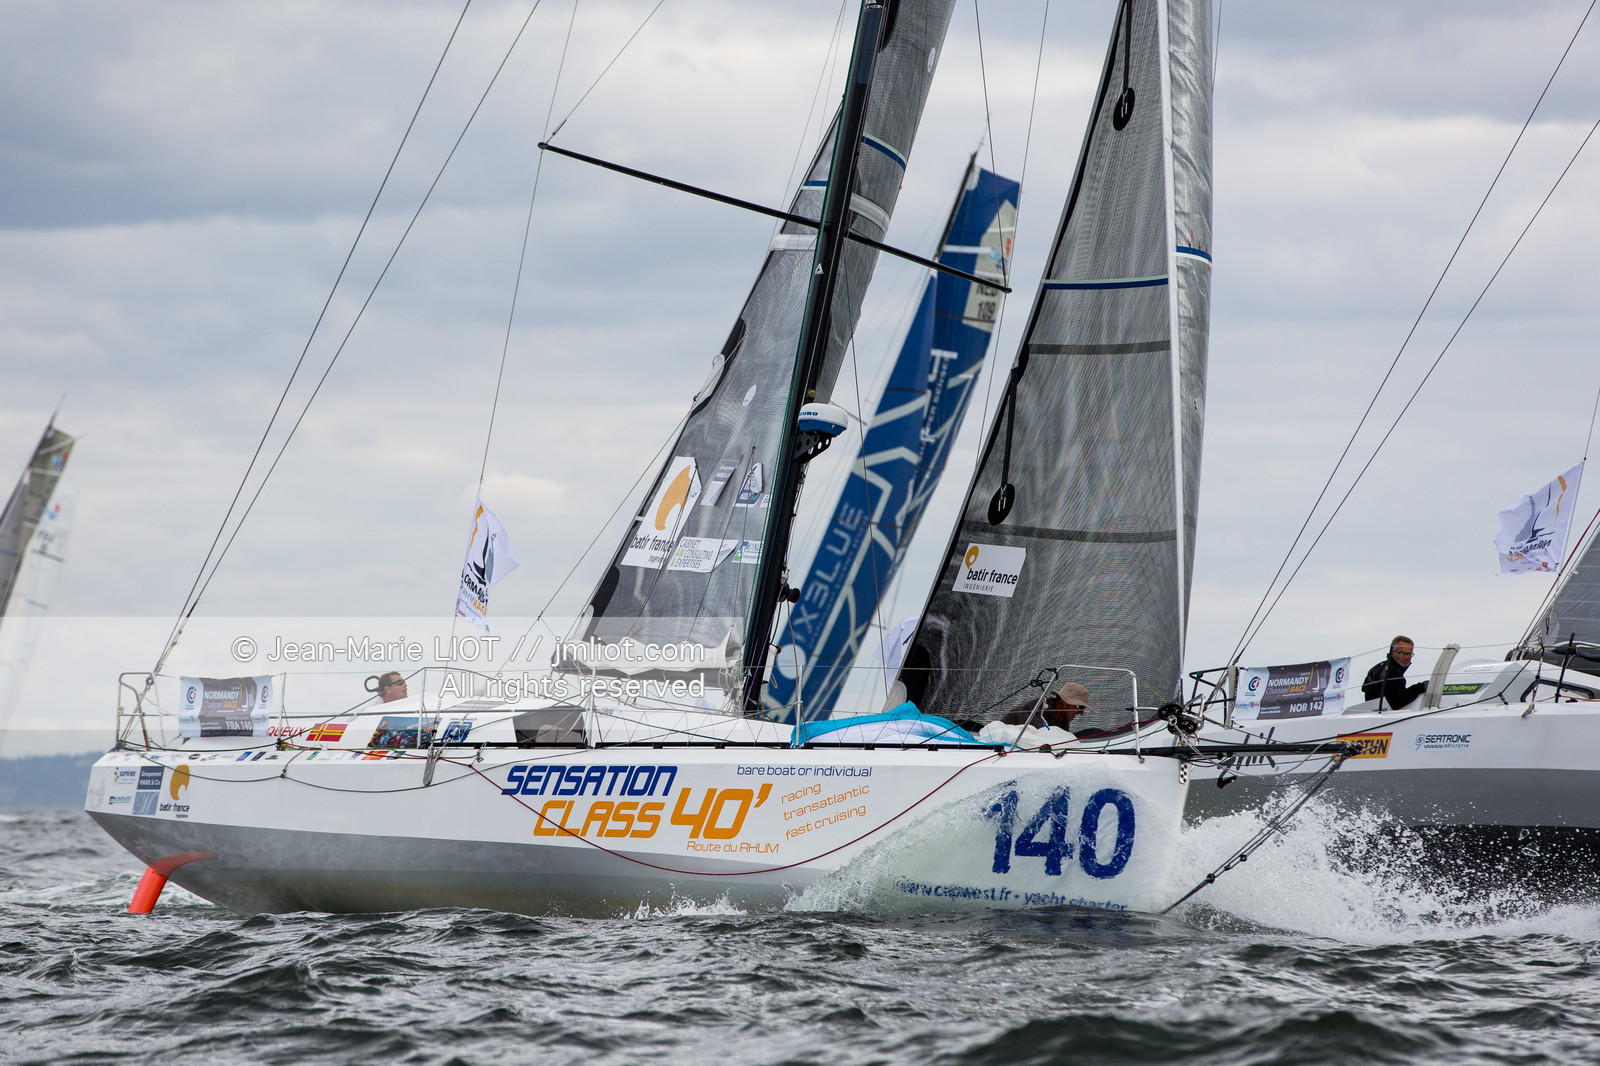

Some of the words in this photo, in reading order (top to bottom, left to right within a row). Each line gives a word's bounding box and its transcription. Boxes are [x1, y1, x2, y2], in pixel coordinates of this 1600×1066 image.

[976, 301, 996, 319] 109
[966, 567, 989, 582] batir
[989, 569, 1018, 585] france
[1267, 676, 1310, 688] NORMANDY
[204, 691, 240, 700] NORMANDY
[1265, 687, 1290, 695] Channel
[1290, 684, 1308, 693] RACE
[203, 700, 223, 708] Channel
[223, 700, 238, 708] RACE
[1289, 703, 1308, 713] NOR
[1309, 701, 1323, 711] 142
[225, 721, 240, 730] FRA
[240, 721, 253, 730] 140
[1425, 734, 1472, 743] SEATRONIC
[737, 764, 765, 776] bare
[767, 765, 796, 776] boat
[797, 767, 813, 776] or
[814, 765, 872, 777] individual
[501, 765, 678, 796] SENSATION
[781, 783, 822, 804] racing
[160, 803, 173, 811] batir
[173, 803, 190, 812] france
[783, 785, 870, 821] transatlantic
[533, 800, 665, 838] CLASS
[785, 822, 813, 840] fast
[814, 805, 867, 830] cruising
[976, 781, 1136, 880] 140
[687, 841, 721, 852] Route
[724, 842, 738, 852] du
[740, 843, 780, 854] RHUM
